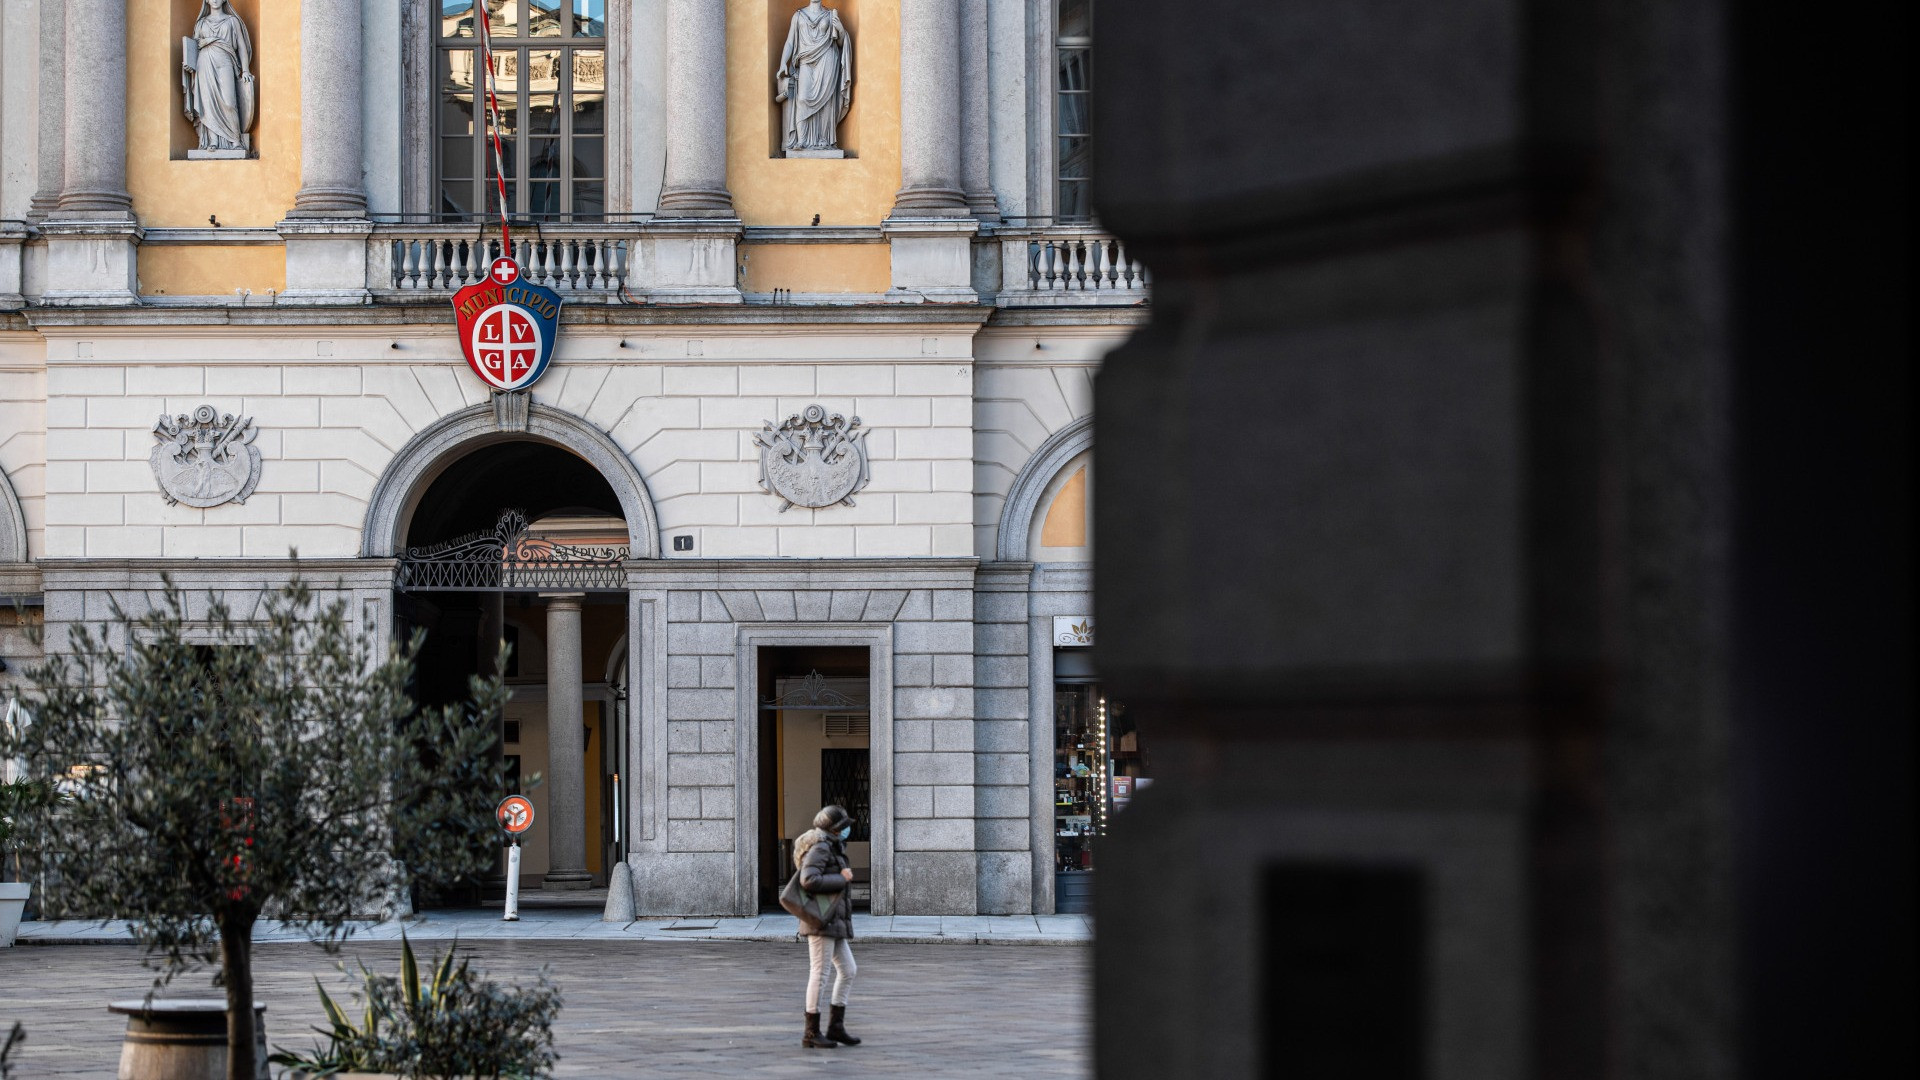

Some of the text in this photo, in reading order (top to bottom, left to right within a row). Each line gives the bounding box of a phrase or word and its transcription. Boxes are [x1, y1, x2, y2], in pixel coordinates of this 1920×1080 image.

[459, 287, 557, 320] MUNICIPIO
[485, 323, 529, 341] L V
[484, 352, 530, 369] G A
[680, 537, 685, 550] 1
